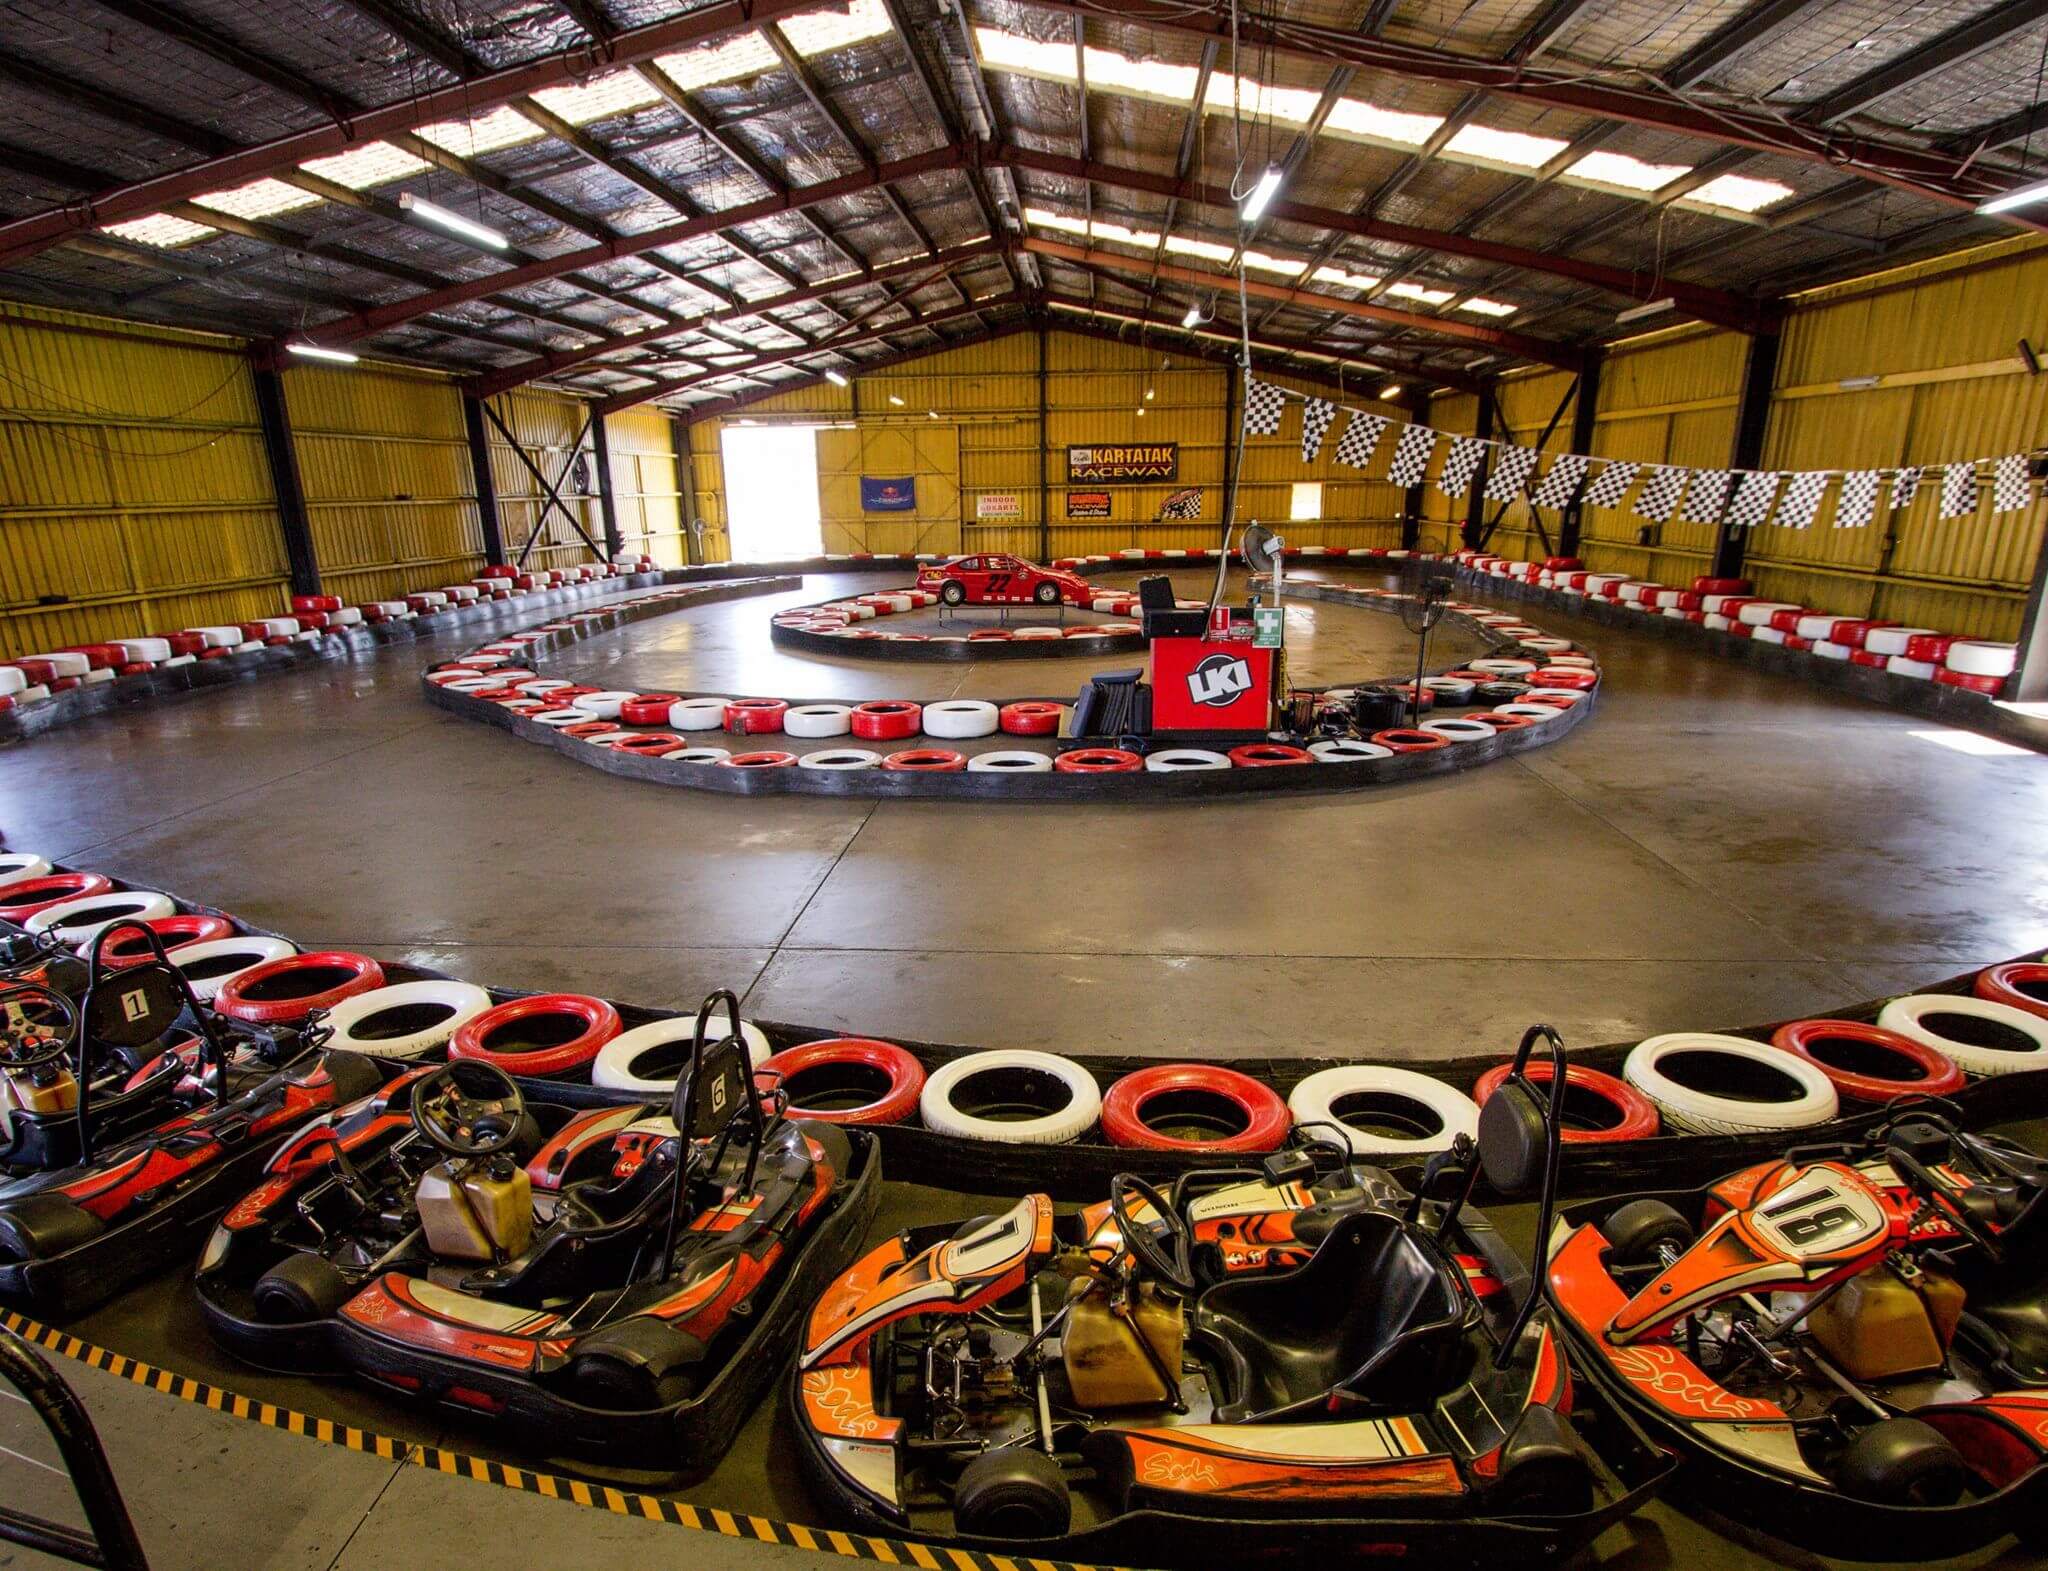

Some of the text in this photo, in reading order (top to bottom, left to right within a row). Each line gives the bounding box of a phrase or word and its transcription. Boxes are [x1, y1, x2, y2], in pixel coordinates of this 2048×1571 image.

[1092, 448, 1173, 464] KARTATAK
[1071, 466, 1173, 478] RACEWAY
[984, 573, 1012, 593] 22
[1187, 659, 1252, 704] LKI
[127, 993, 146, 1018] 1
[714, 1078, 724, 1106] 6
[1757, 1185, 1868, 1248] 18
[1143, 1451, 1220, 1488] Sodi
